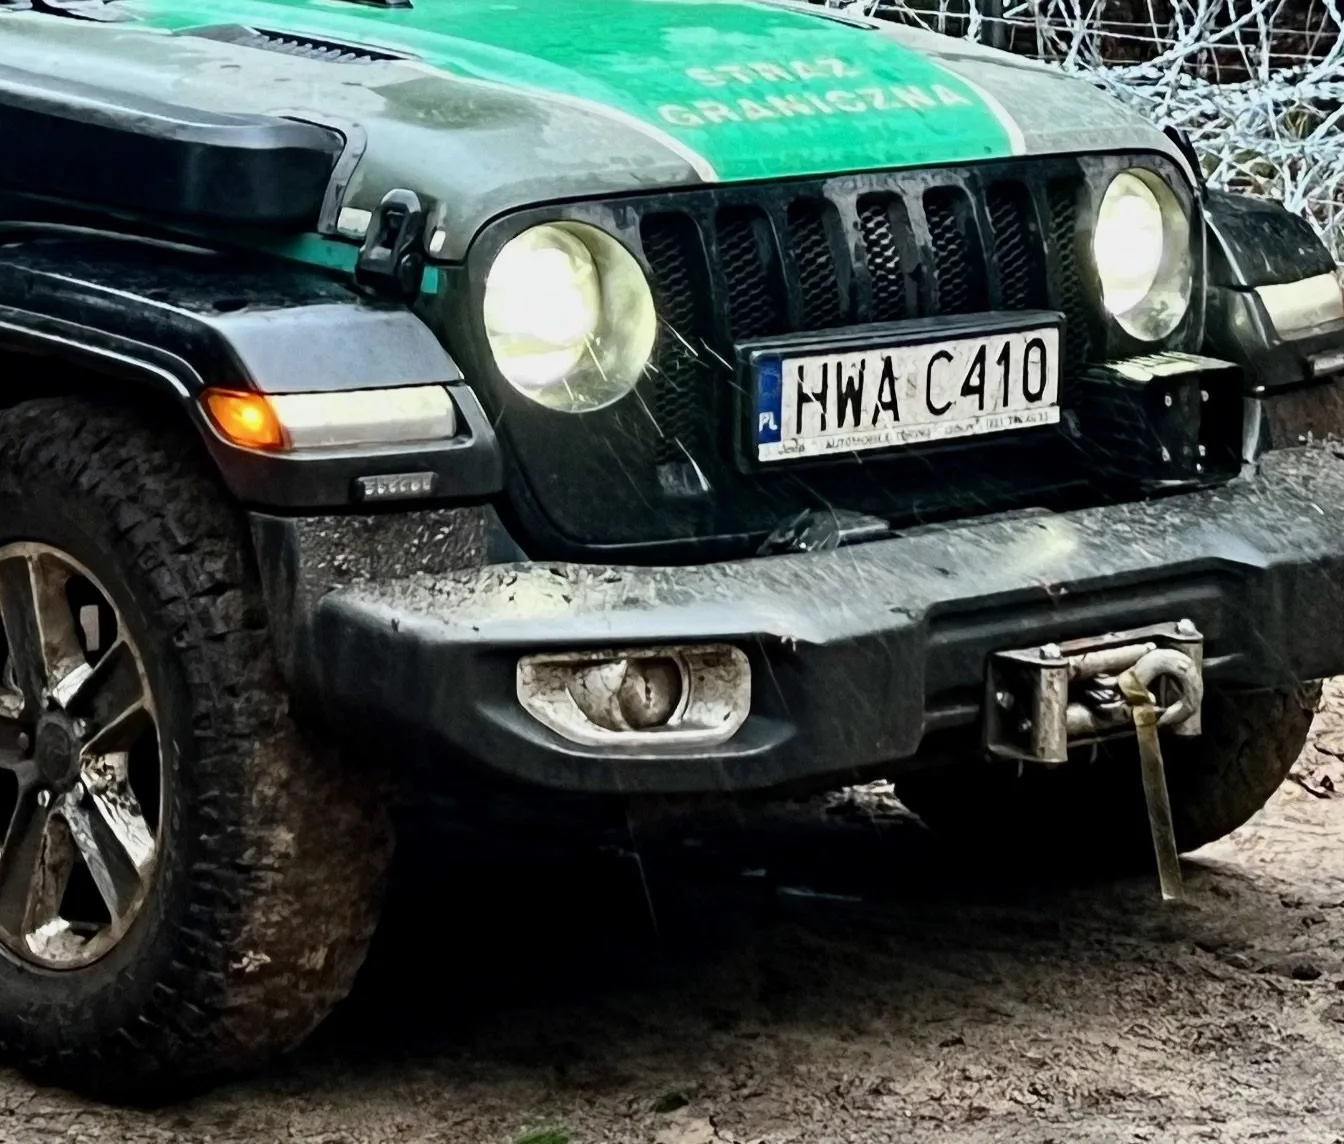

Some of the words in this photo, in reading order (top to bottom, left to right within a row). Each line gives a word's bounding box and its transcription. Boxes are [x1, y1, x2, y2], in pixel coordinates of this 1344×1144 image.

[658, 84, 971, 126] GRANICZNA
[796, 355, 901, 434] HWA
[926, 337, 1048, 416] C410
[758, 412, 778, 433] PL
